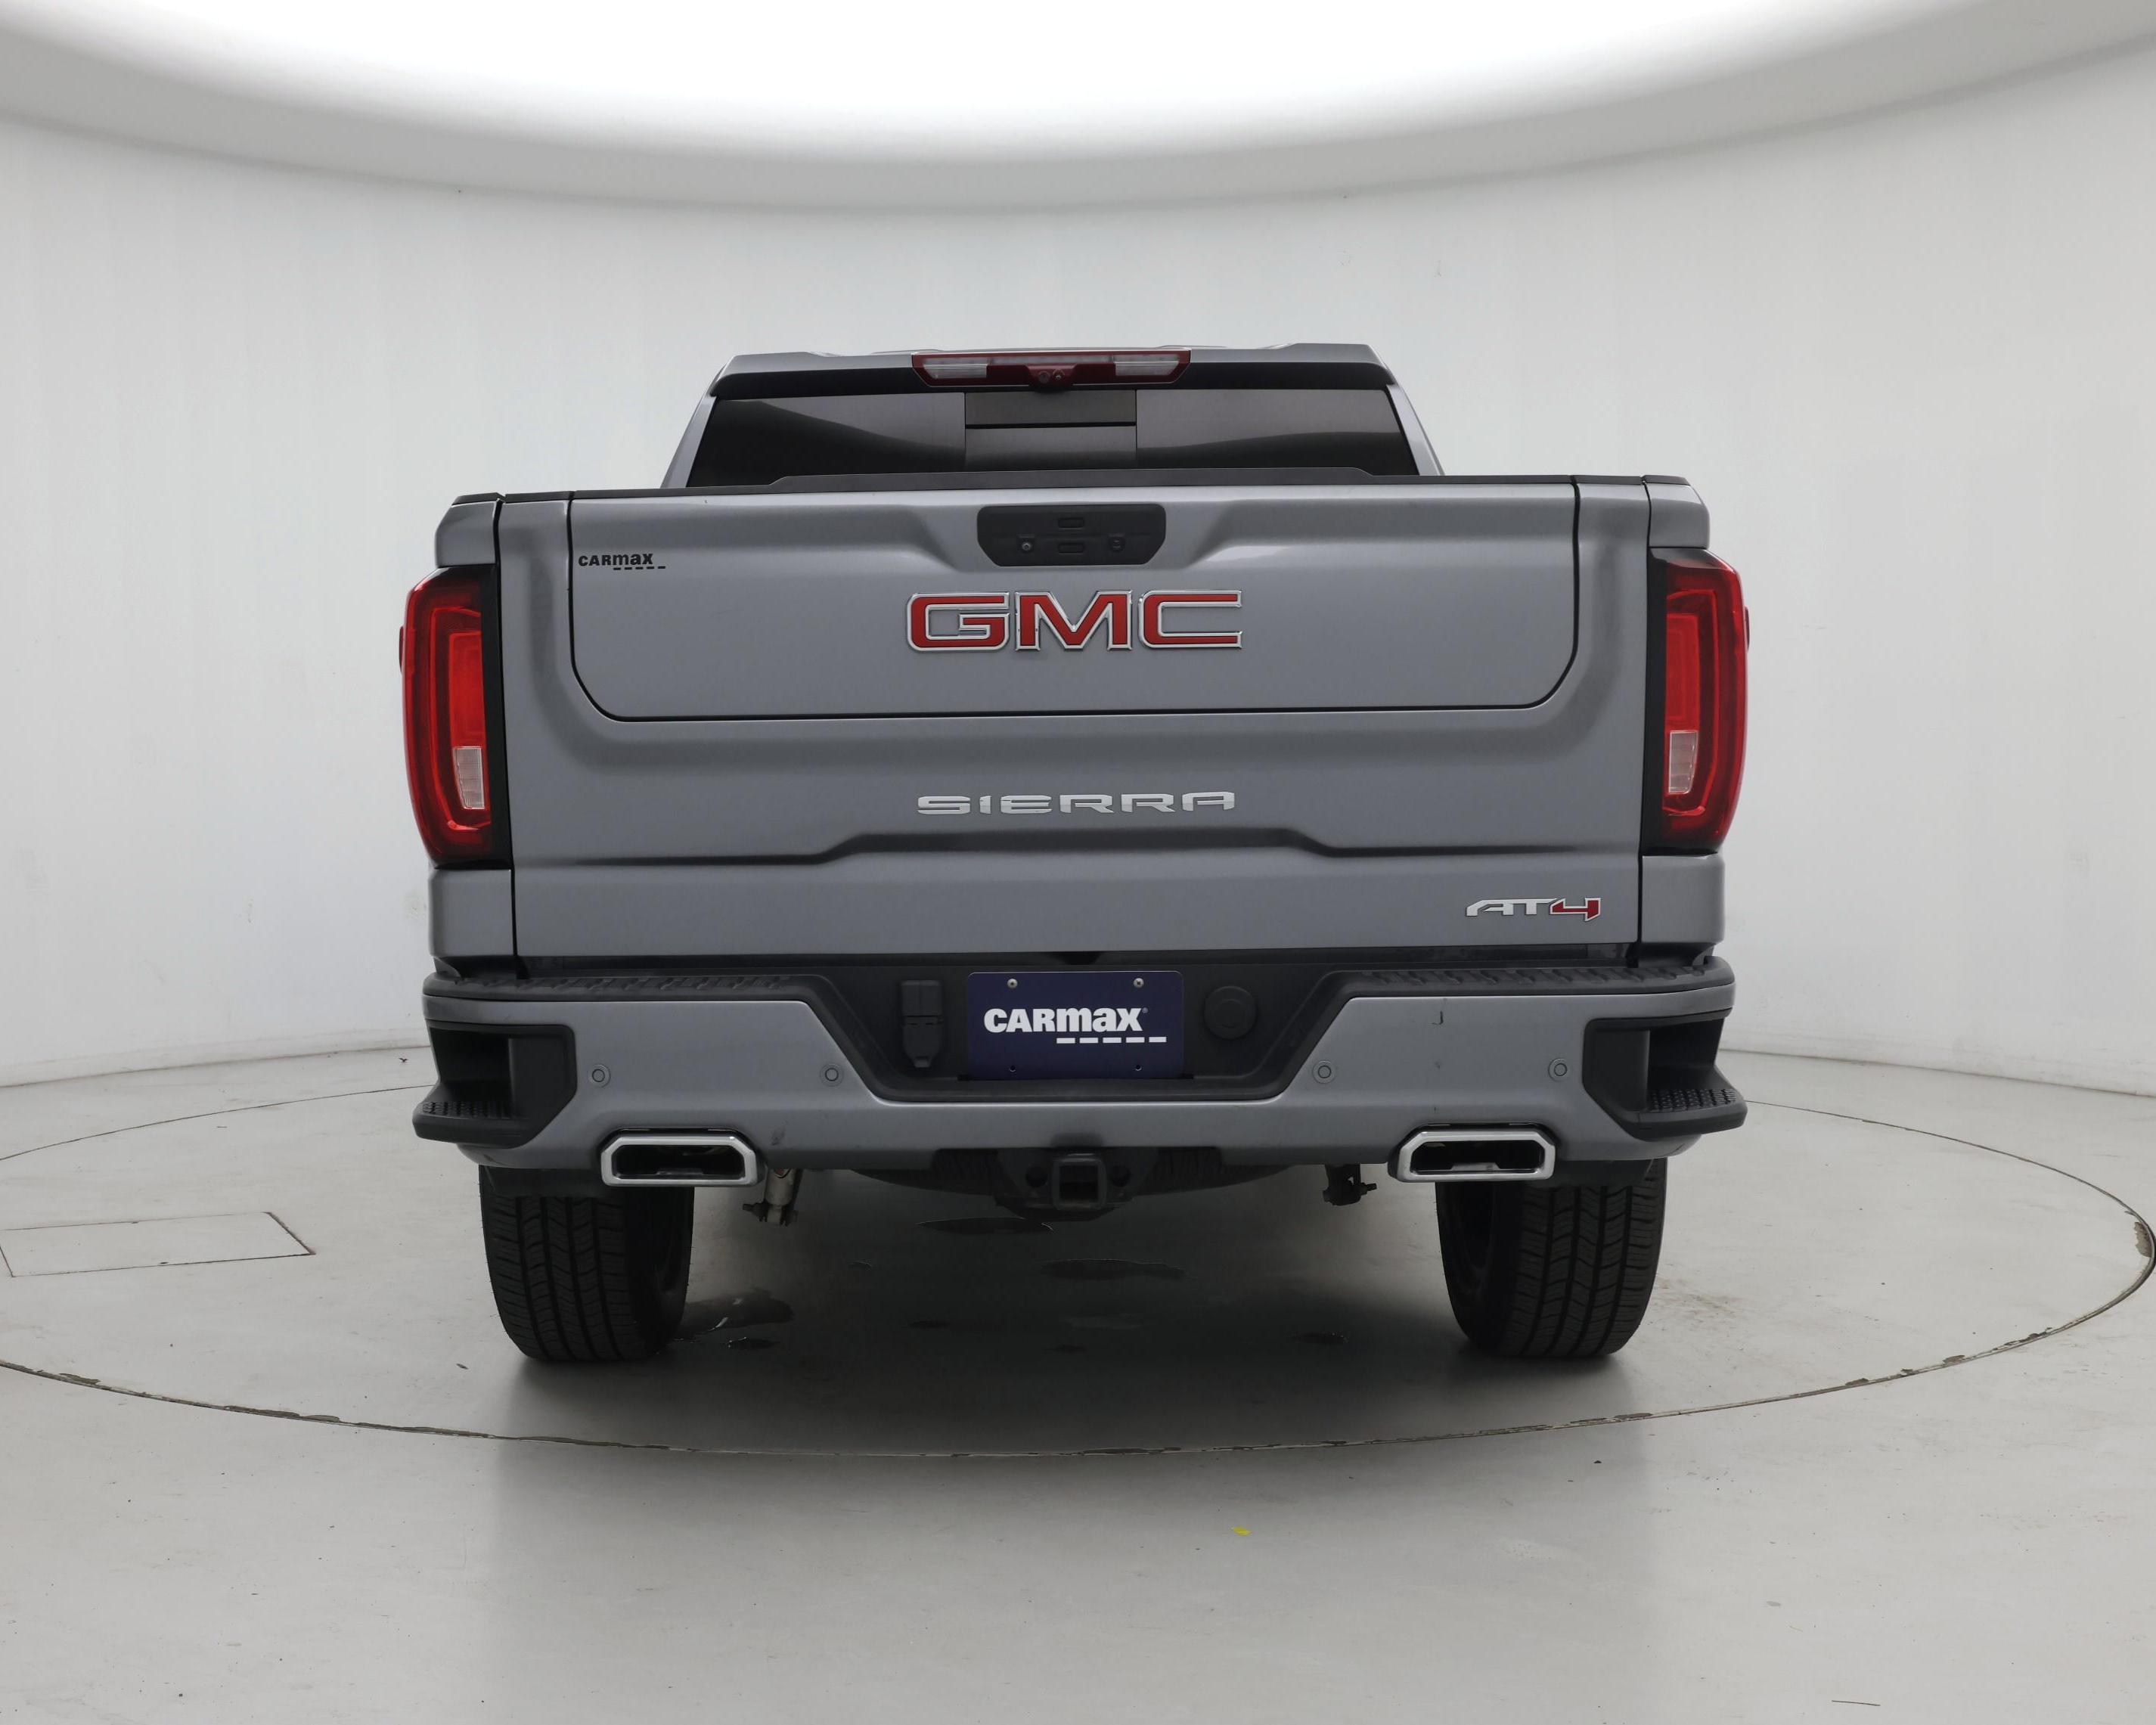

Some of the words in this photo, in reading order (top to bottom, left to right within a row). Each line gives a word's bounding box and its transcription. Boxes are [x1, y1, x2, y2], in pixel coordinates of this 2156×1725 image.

[907, 590, 1242, 651] GMC
[917, 792, 1235, 814] SIERRA
[1466, 897, 1601, 921] AT4
